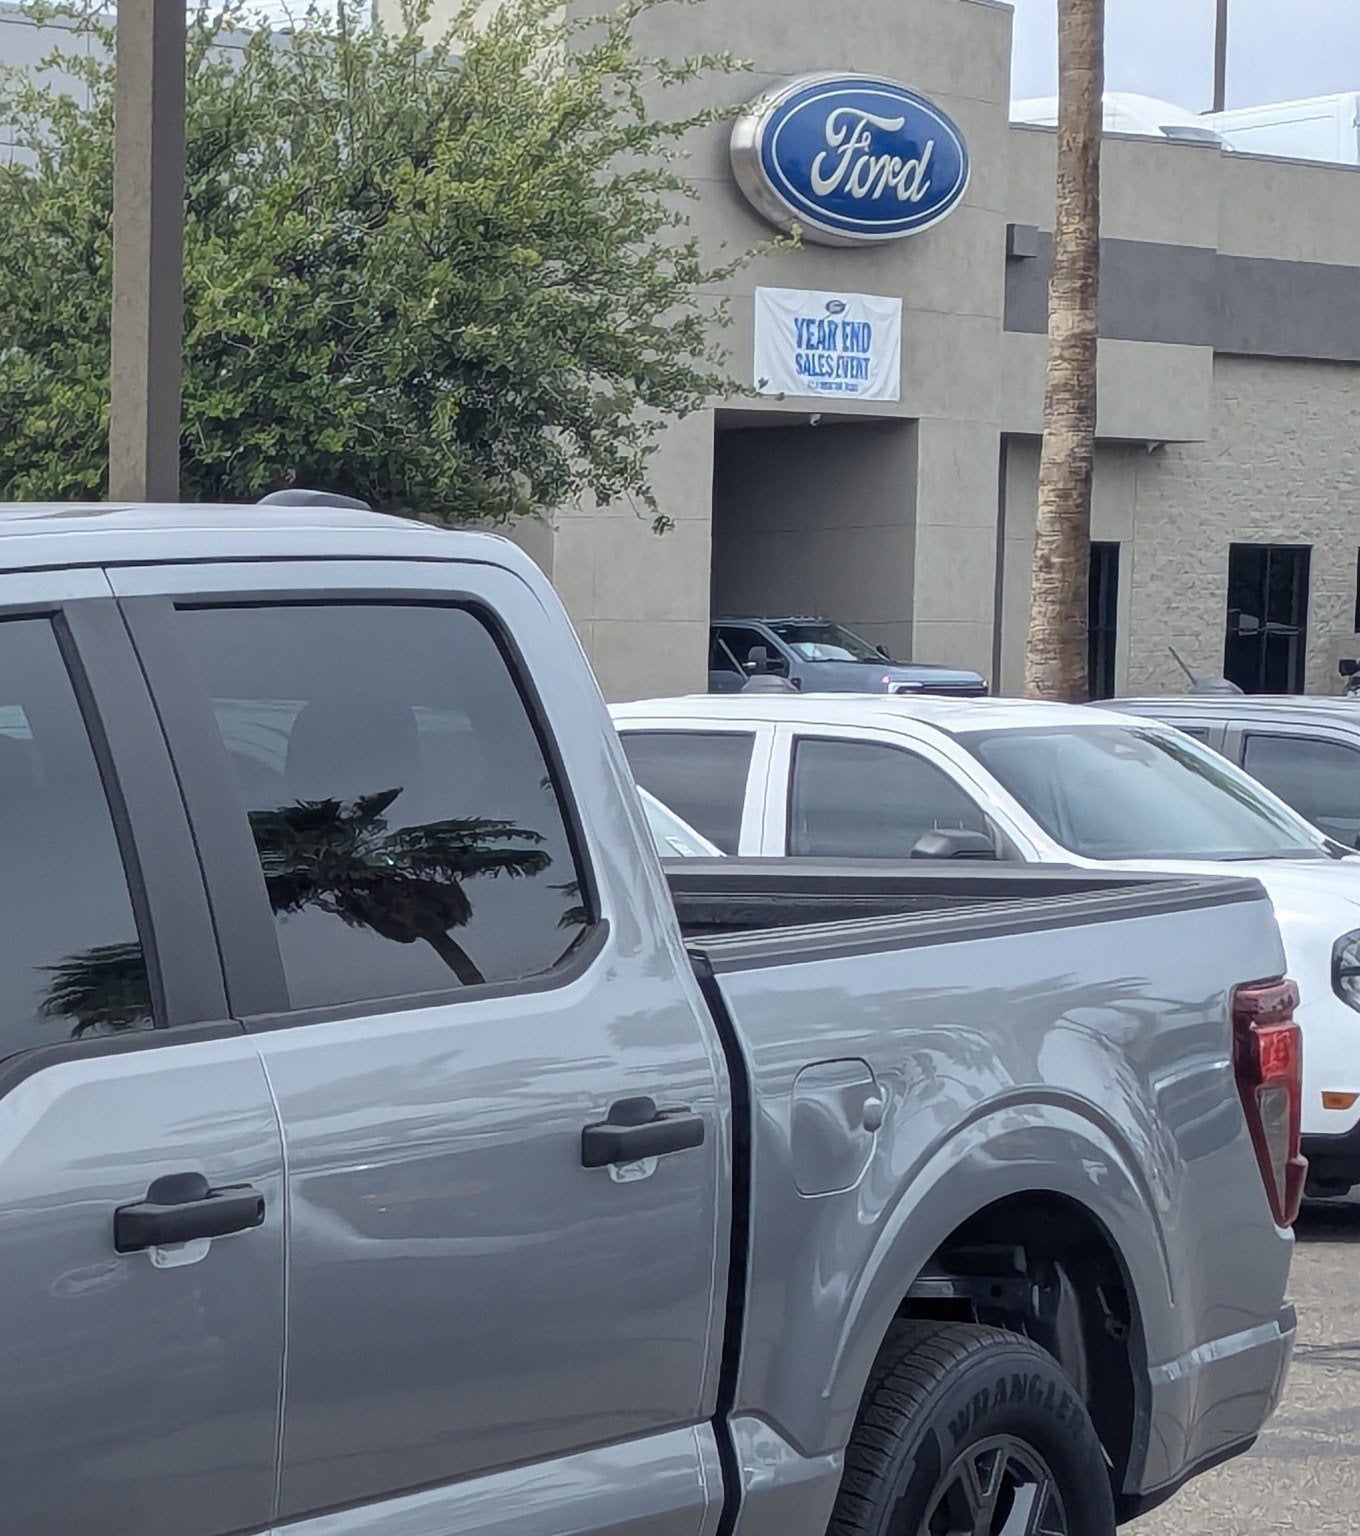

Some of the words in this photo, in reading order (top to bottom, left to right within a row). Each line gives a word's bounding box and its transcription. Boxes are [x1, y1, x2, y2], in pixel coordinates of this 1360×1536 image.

[811, 107, 935, 203] Ford
[794, 317, 838, 351] YEAR
[841, 320, 872, 354] END
[795, 353, 834, 377] SALES
[835, 356, 870, 380] EVENT
